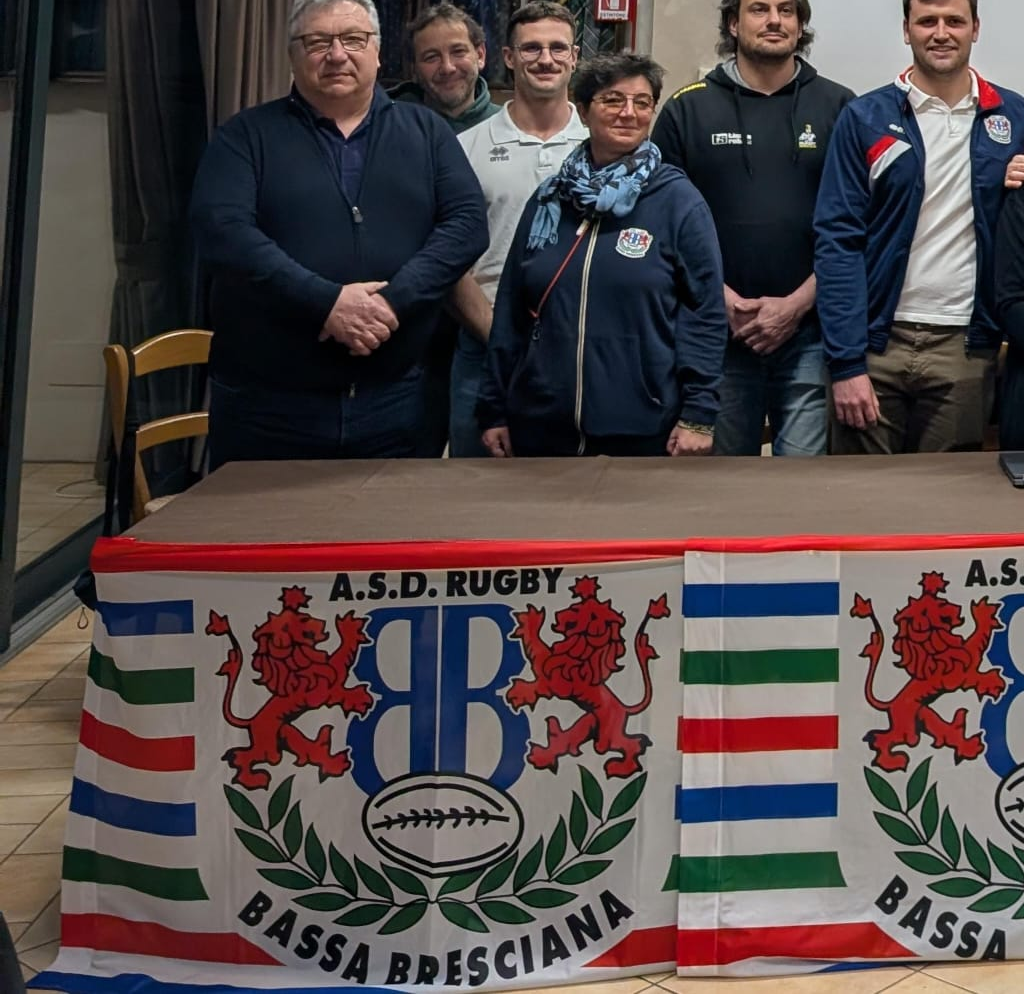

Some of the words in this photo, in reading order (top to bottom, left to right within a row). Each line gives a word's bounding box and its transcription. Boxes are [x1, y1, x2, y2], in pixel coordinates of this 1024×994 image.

[329, 571, 438, 601] A.S.D.
[446, 567, 565, 598] RUGBY
[237, 890, 371, 985] BASSA
[384, 889, 635, 987] BRESCIANA
[874, 874, 1007, 961] BASSA
